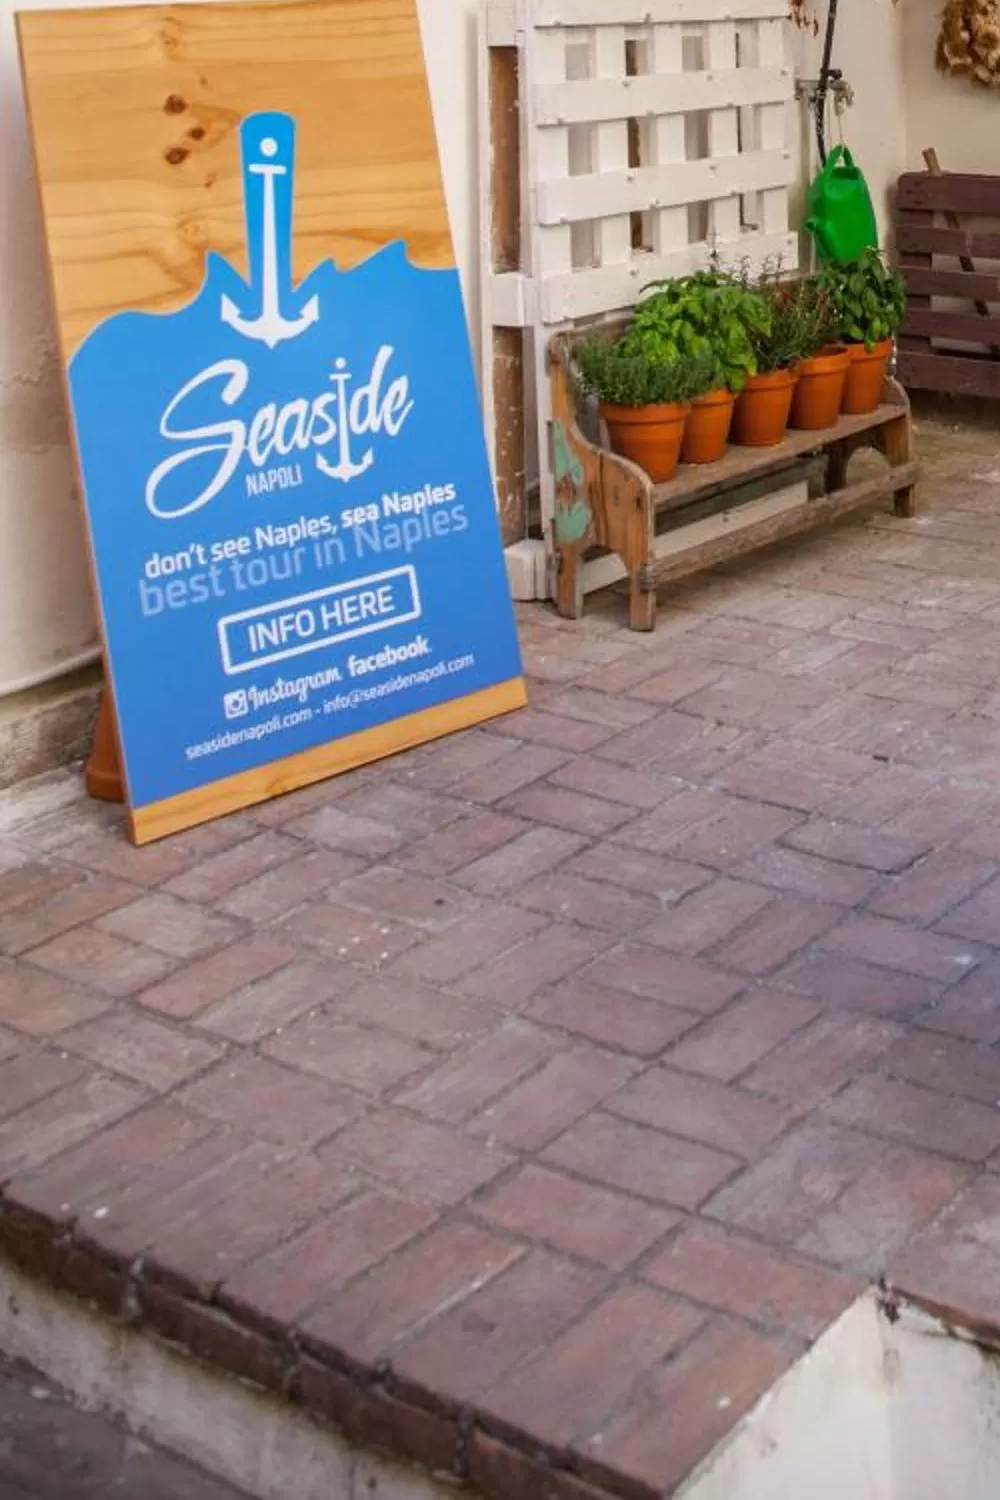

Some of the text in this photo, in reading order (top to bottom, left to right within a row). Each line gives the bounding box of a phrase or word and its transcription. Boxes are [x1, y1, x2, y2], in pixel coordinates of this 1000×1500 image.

[145, 345, 414, 519] Seaside
[245, 463, 303, 496] NAPOLI
[138, 503, 469, 616] best tour in Naples
[210, 536, 251, 562] see
[255, 516, 337, 551] Naples,
[341, 503, 379, 528] sea
[382, 481, 457, 514] Naples
[248, 585, 396, 653] INFO HERE
[185, 706, 313, 760] seasidenapoli.com
[323, 653, 474, 714] info@seasidenapoli.com
[248, 666, 342, 710] Instagram
